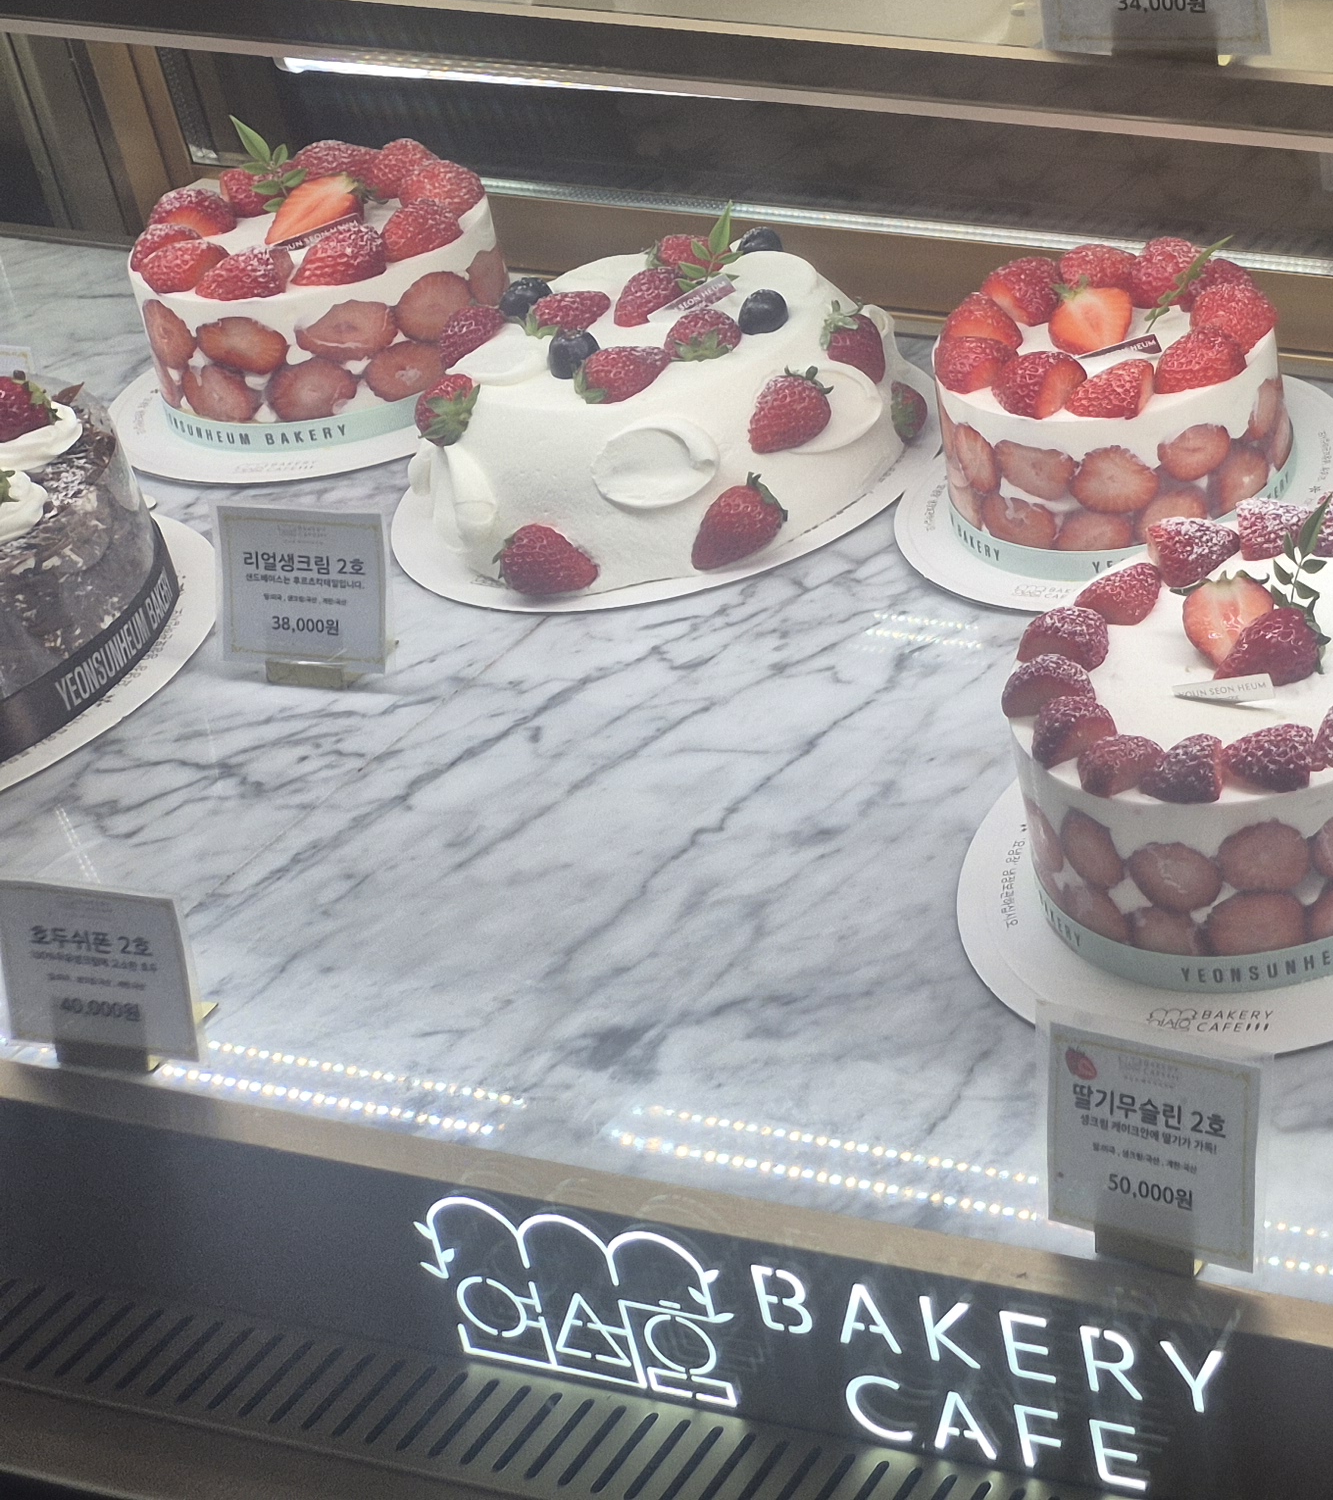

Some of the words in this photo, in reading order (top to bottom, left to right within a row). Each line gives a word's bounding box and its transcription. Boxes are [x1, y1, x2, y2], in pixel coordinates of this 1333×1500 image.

[1129, 338, 1157, 352] HEUM
[264, 423, 348, 447] BAKERY
[242, 550, 330, 575] 리얼생크림
[337, 558, 366, 576] 2호
[271, 615, 340, 636] 38,000원
[55, 608, 151, 711] YEONSUNHEUM
[1208, 685, 1235, 696] SEON
[1237, 681, 1267, 692] HEUM
[1000, 867, 1019, 929] 냉장보관하십시오
[29, 924, 113, 955] 호두쉬폰
[118, 936, 153, 957] 2호
[1196, 1022, 1242, 1033] CAFE
[1201, 1009, 1274, 1021] BAKERY
[1072, 1082, 1183, 1131] 딸기무슬린
[1190, 1110, 1227, 1140] 2호
[1080, 1113, 1110, 1130] 생크림
[1111, 1120, 1160, 1141] 케이크안에
[1162, 1132, 1192, 1149] 딸기가
[1193, 1139, 1218, 1156] 가득!
[1107, 1172, 1194, 1212] 50,000원
[749, 1262, 1224, 1414] BAKERY
[844, 1373, 1147, 1492] CAFE
